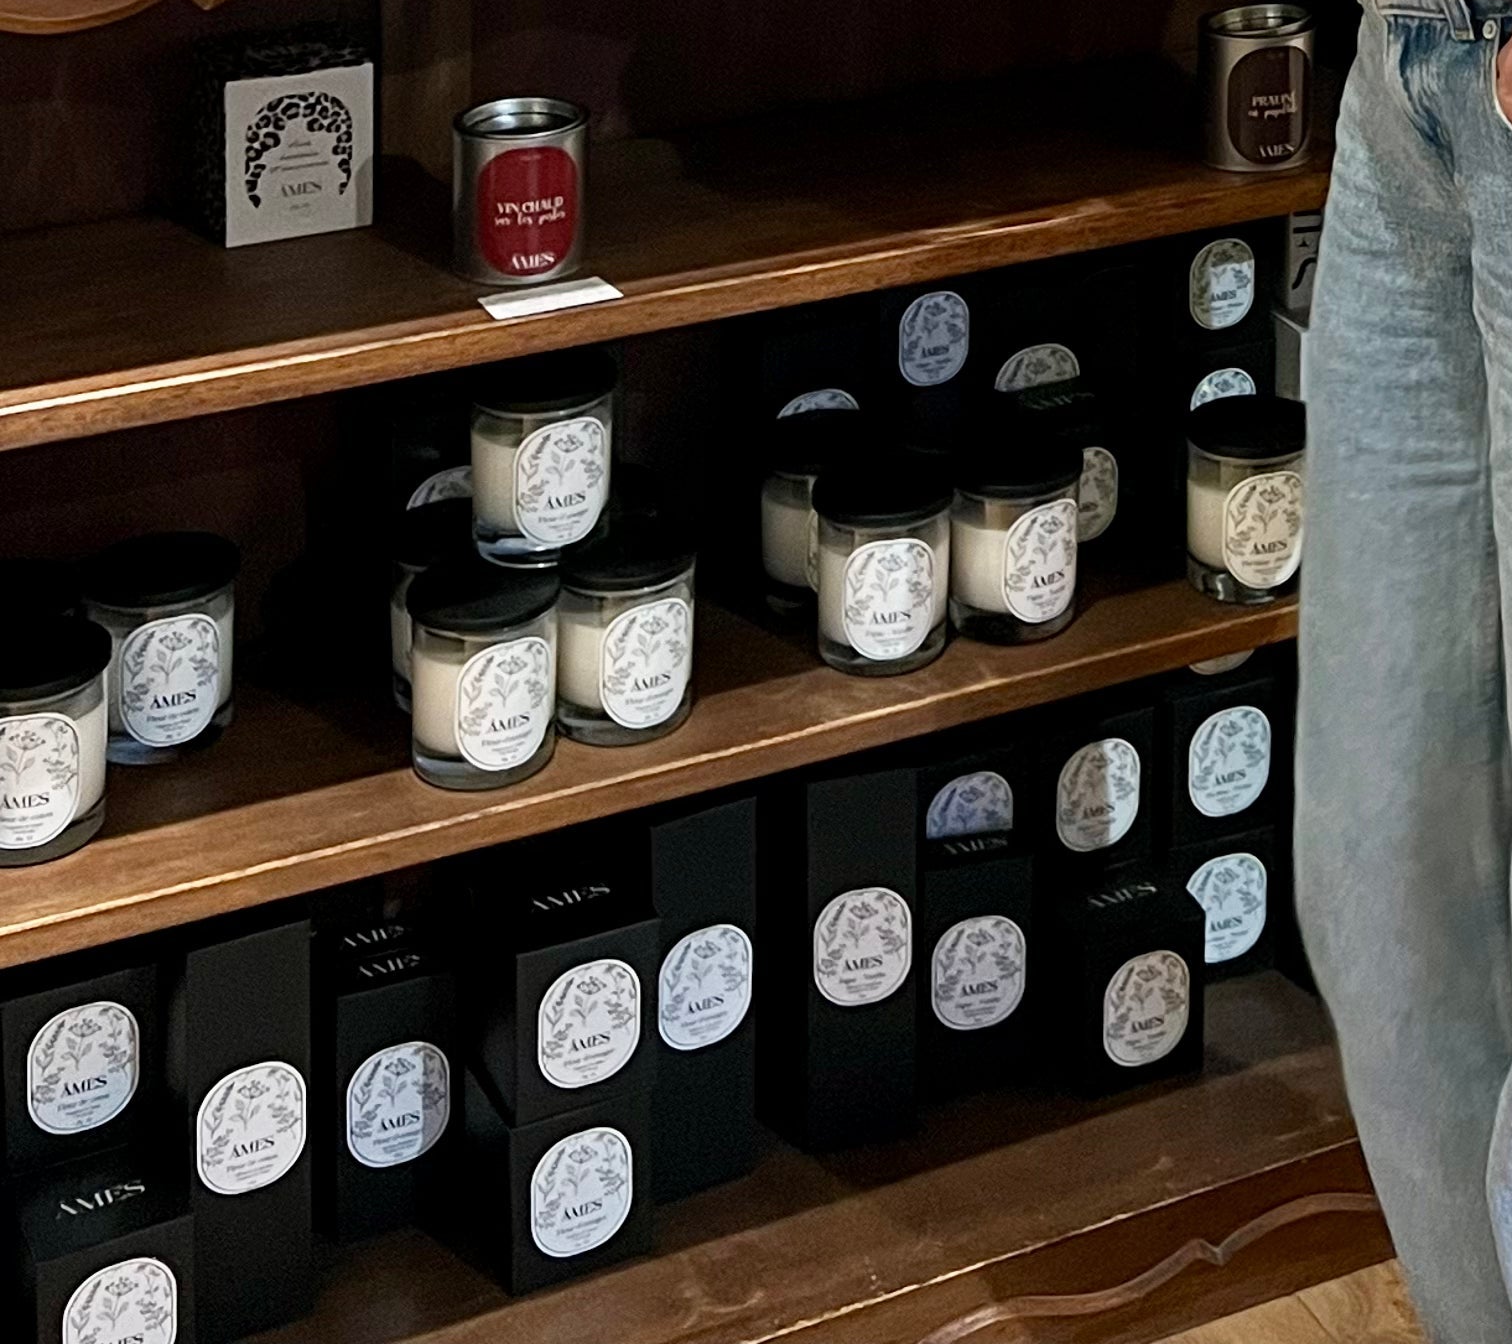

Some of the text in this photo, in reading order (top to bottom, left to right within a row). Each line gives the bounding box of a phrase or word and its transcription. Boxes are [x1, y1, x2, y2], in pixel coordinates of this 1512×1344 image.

[496, 202, 520, 214] VIN
[544, 490, 586, 510] ÂMES
[630, 673, 671, 693] ÂMES
[149, 689, 197, 710] ÂMES
[488, 712, 530, 733] ÂMES
[568, 1032, 611, 1053] ÂMES
[60, 1076, 108, 1098] ÂMES
[377, 1110, 421, 1133] ÂMES
[228, 1136, 275, 1160] ÂMES
[561, 1200, 603, 1221] ÂMES
